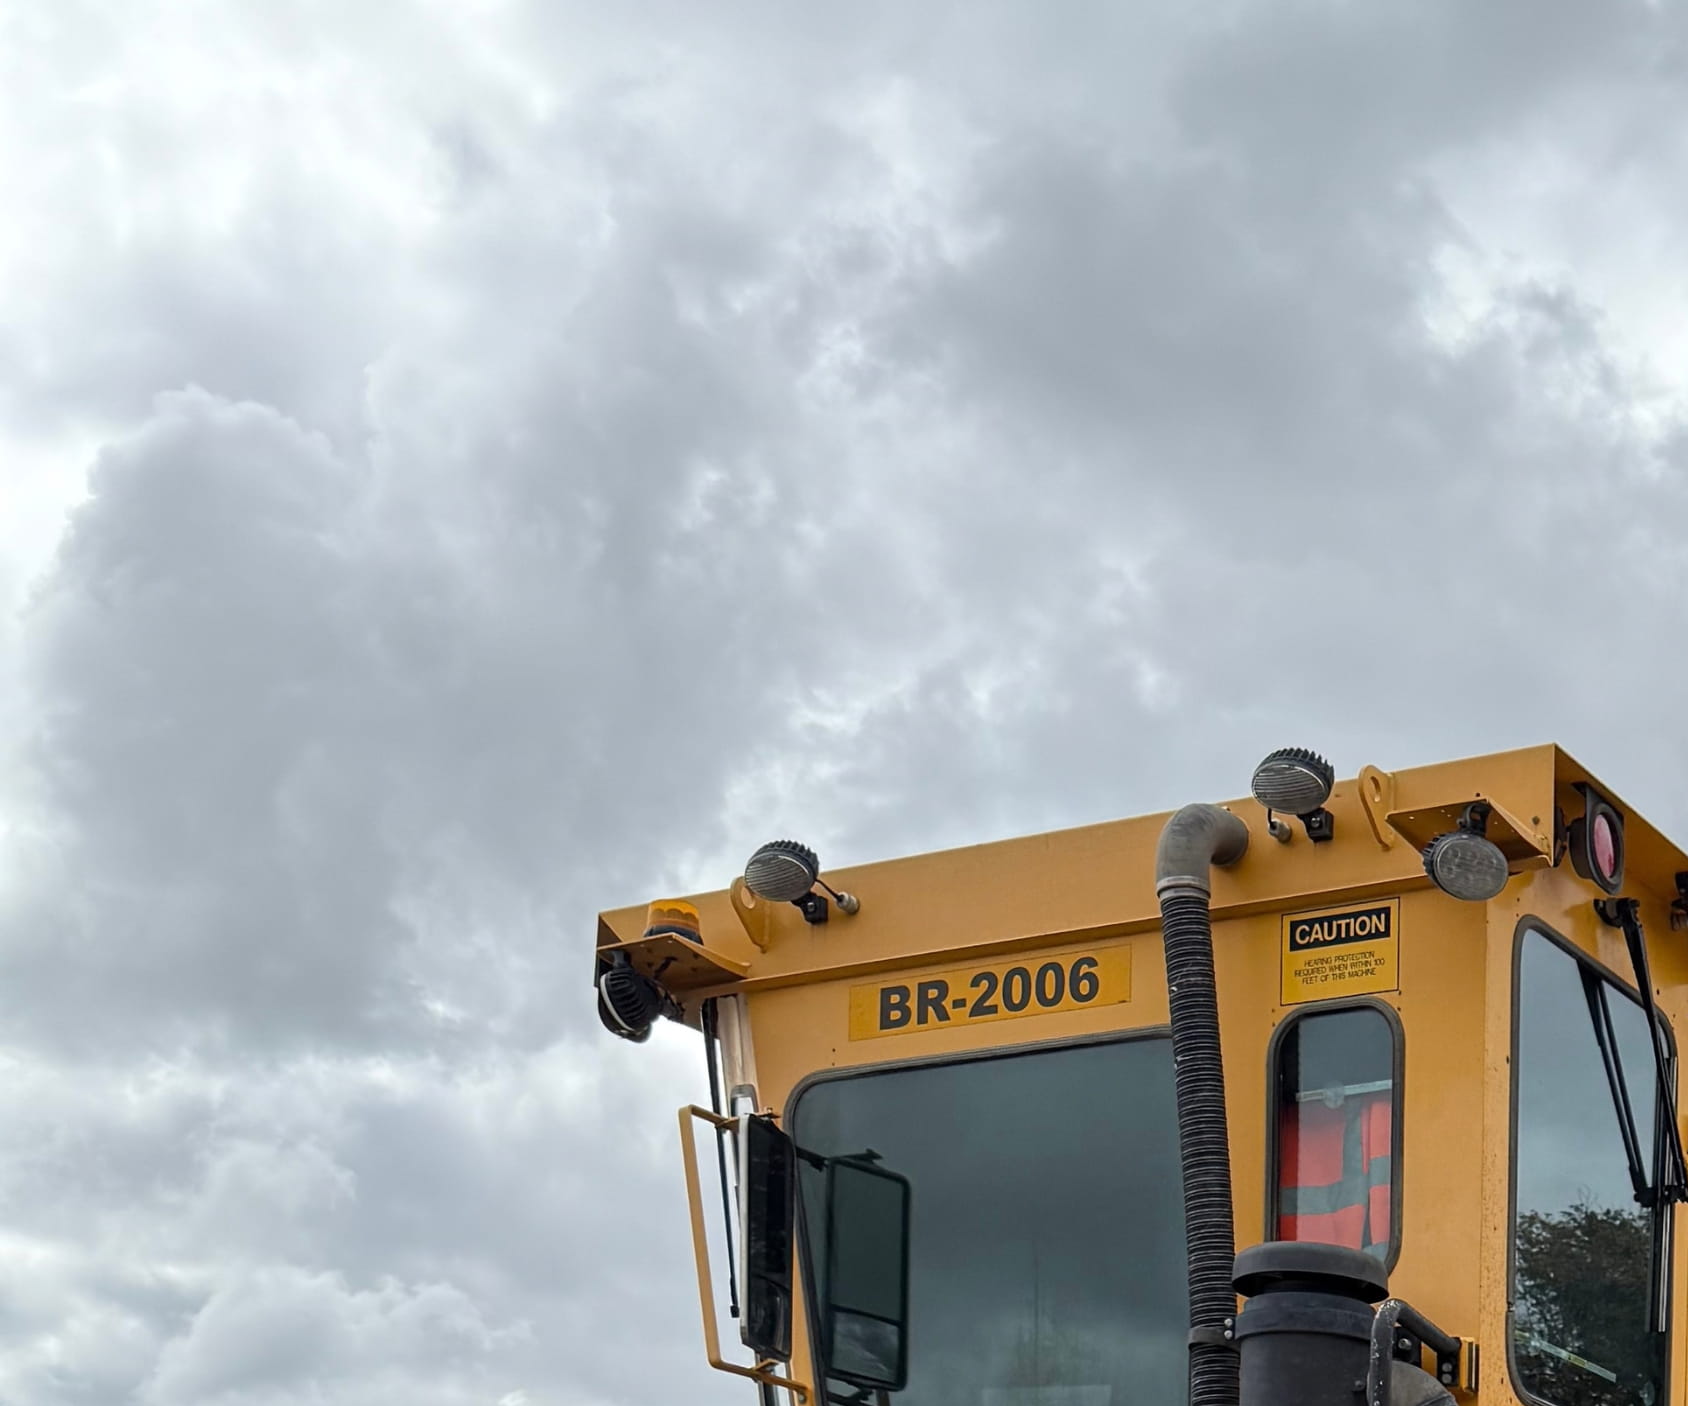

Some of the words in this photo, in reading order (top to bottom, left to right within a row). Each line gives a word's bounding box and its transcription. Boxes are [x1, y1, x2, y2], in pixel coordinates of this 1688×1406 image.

[1295, 913, 1386, 945] CAUTION
[1294, 966, 1326, 977] REQUIRED
[1329, 963, 1348, 973] WHEN
[1350, 960, 1371, 970] WITHIN
[1374, 958, 1385, 966] 100
[1304, 956, 1332, 967] HEARING
[1334, 951, 1375, 962] PROTECTION
[1303, 976, 1317, 985] FEET
[1320, 974, 1329, 983] OF
[1332, 973, 1346, 981] THIS
[1348, 968, 1376, 978] MACHINE
[879, 957, 1099, 1030] BR-2006
